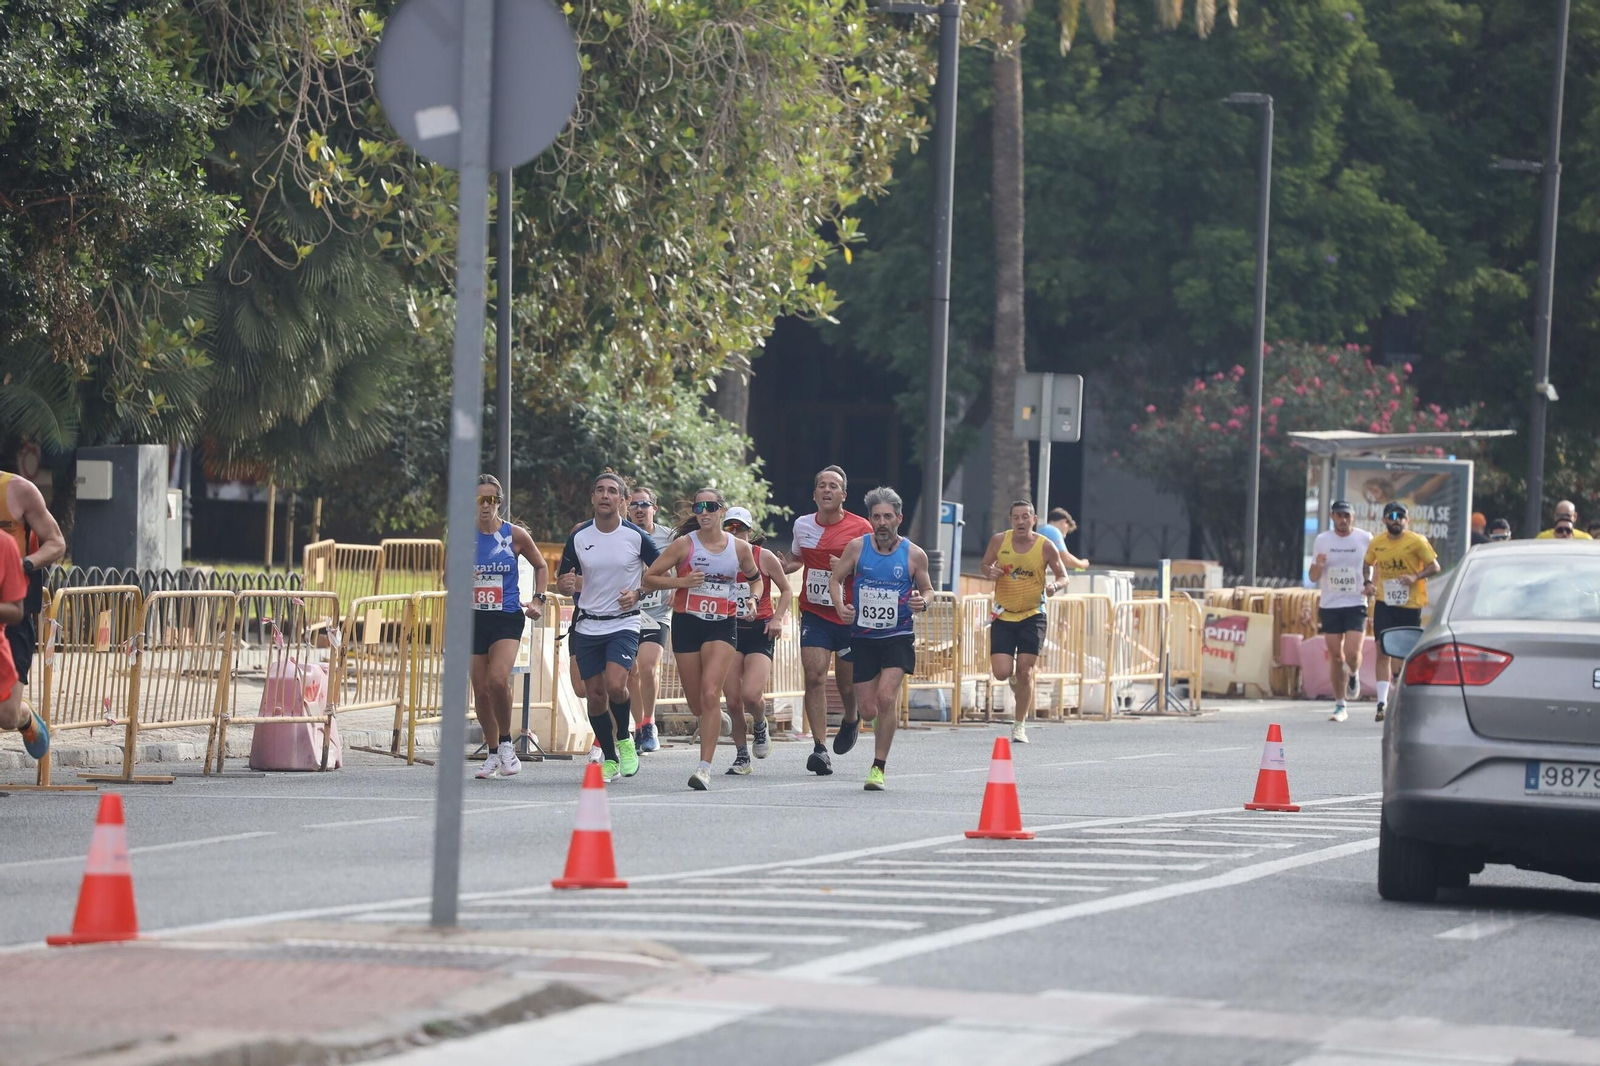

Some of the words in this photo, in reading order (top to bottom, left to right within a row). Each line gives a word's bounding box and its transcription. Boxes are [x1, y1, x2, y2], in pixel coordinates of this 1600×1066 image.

[1437, 505, 1450, 522] SE
[807, 582, 830, 596] 107
[1387, 590, 1408, 600] 1625
[477, 590, 496, 604] 86
[700, 599, 718, 615] 60
[862, 605, 895, 620] 6329
